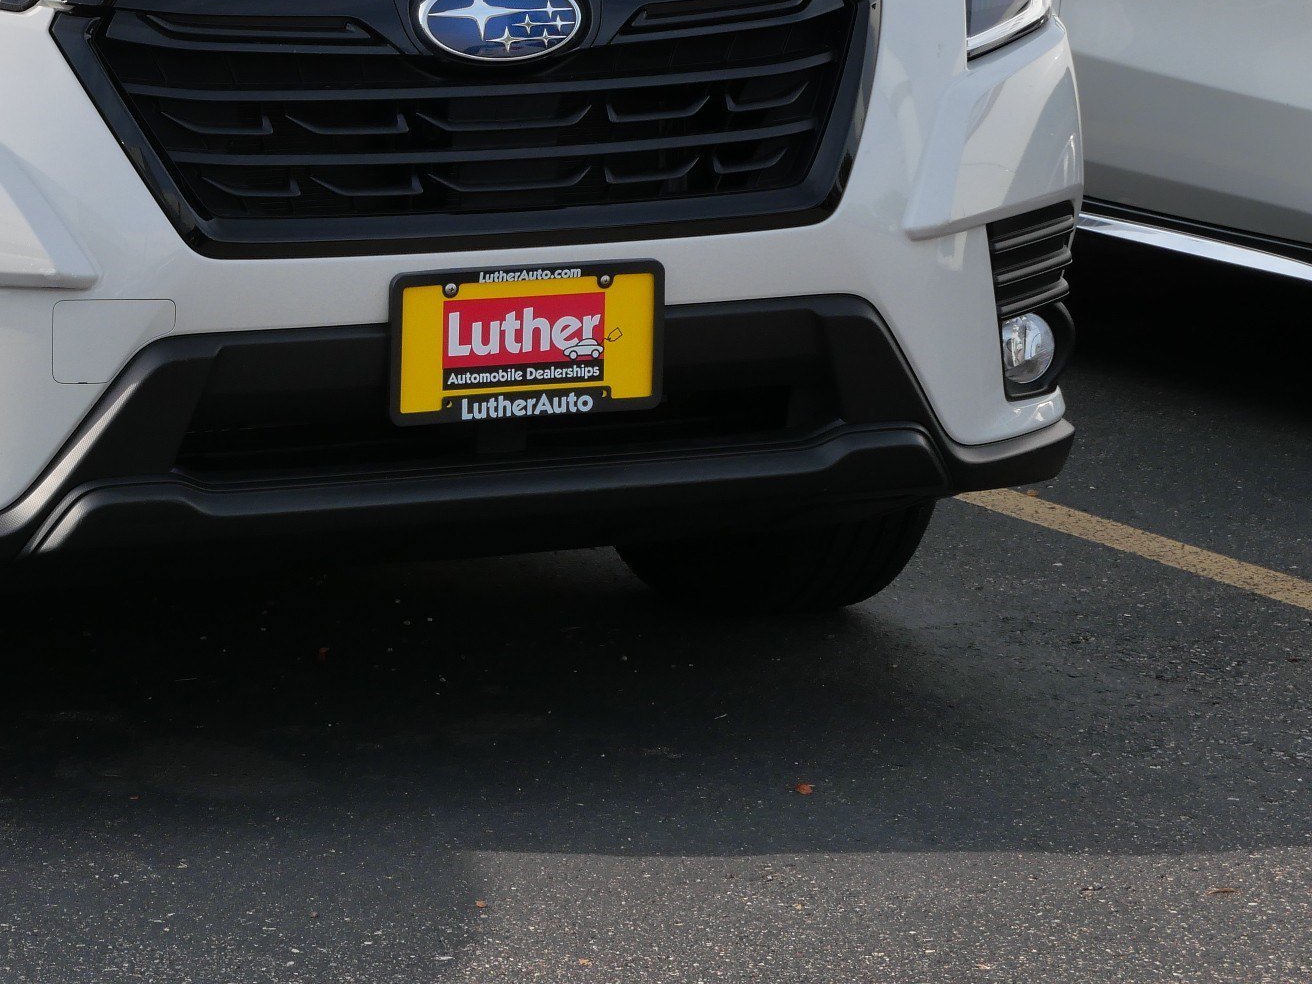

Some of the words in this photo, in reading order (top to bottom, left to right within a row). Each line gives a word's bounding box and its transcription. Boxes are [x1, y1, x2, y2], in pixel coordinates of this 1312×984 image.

[478, 268, 581, 283] LutherAuto.com
[447, 306, 602, 357] Luther
[447, 366, 523, 385] Automobile
[526, 364, 600, 380] Dealerships
[461, 392, 594, 421] LutherAuto
